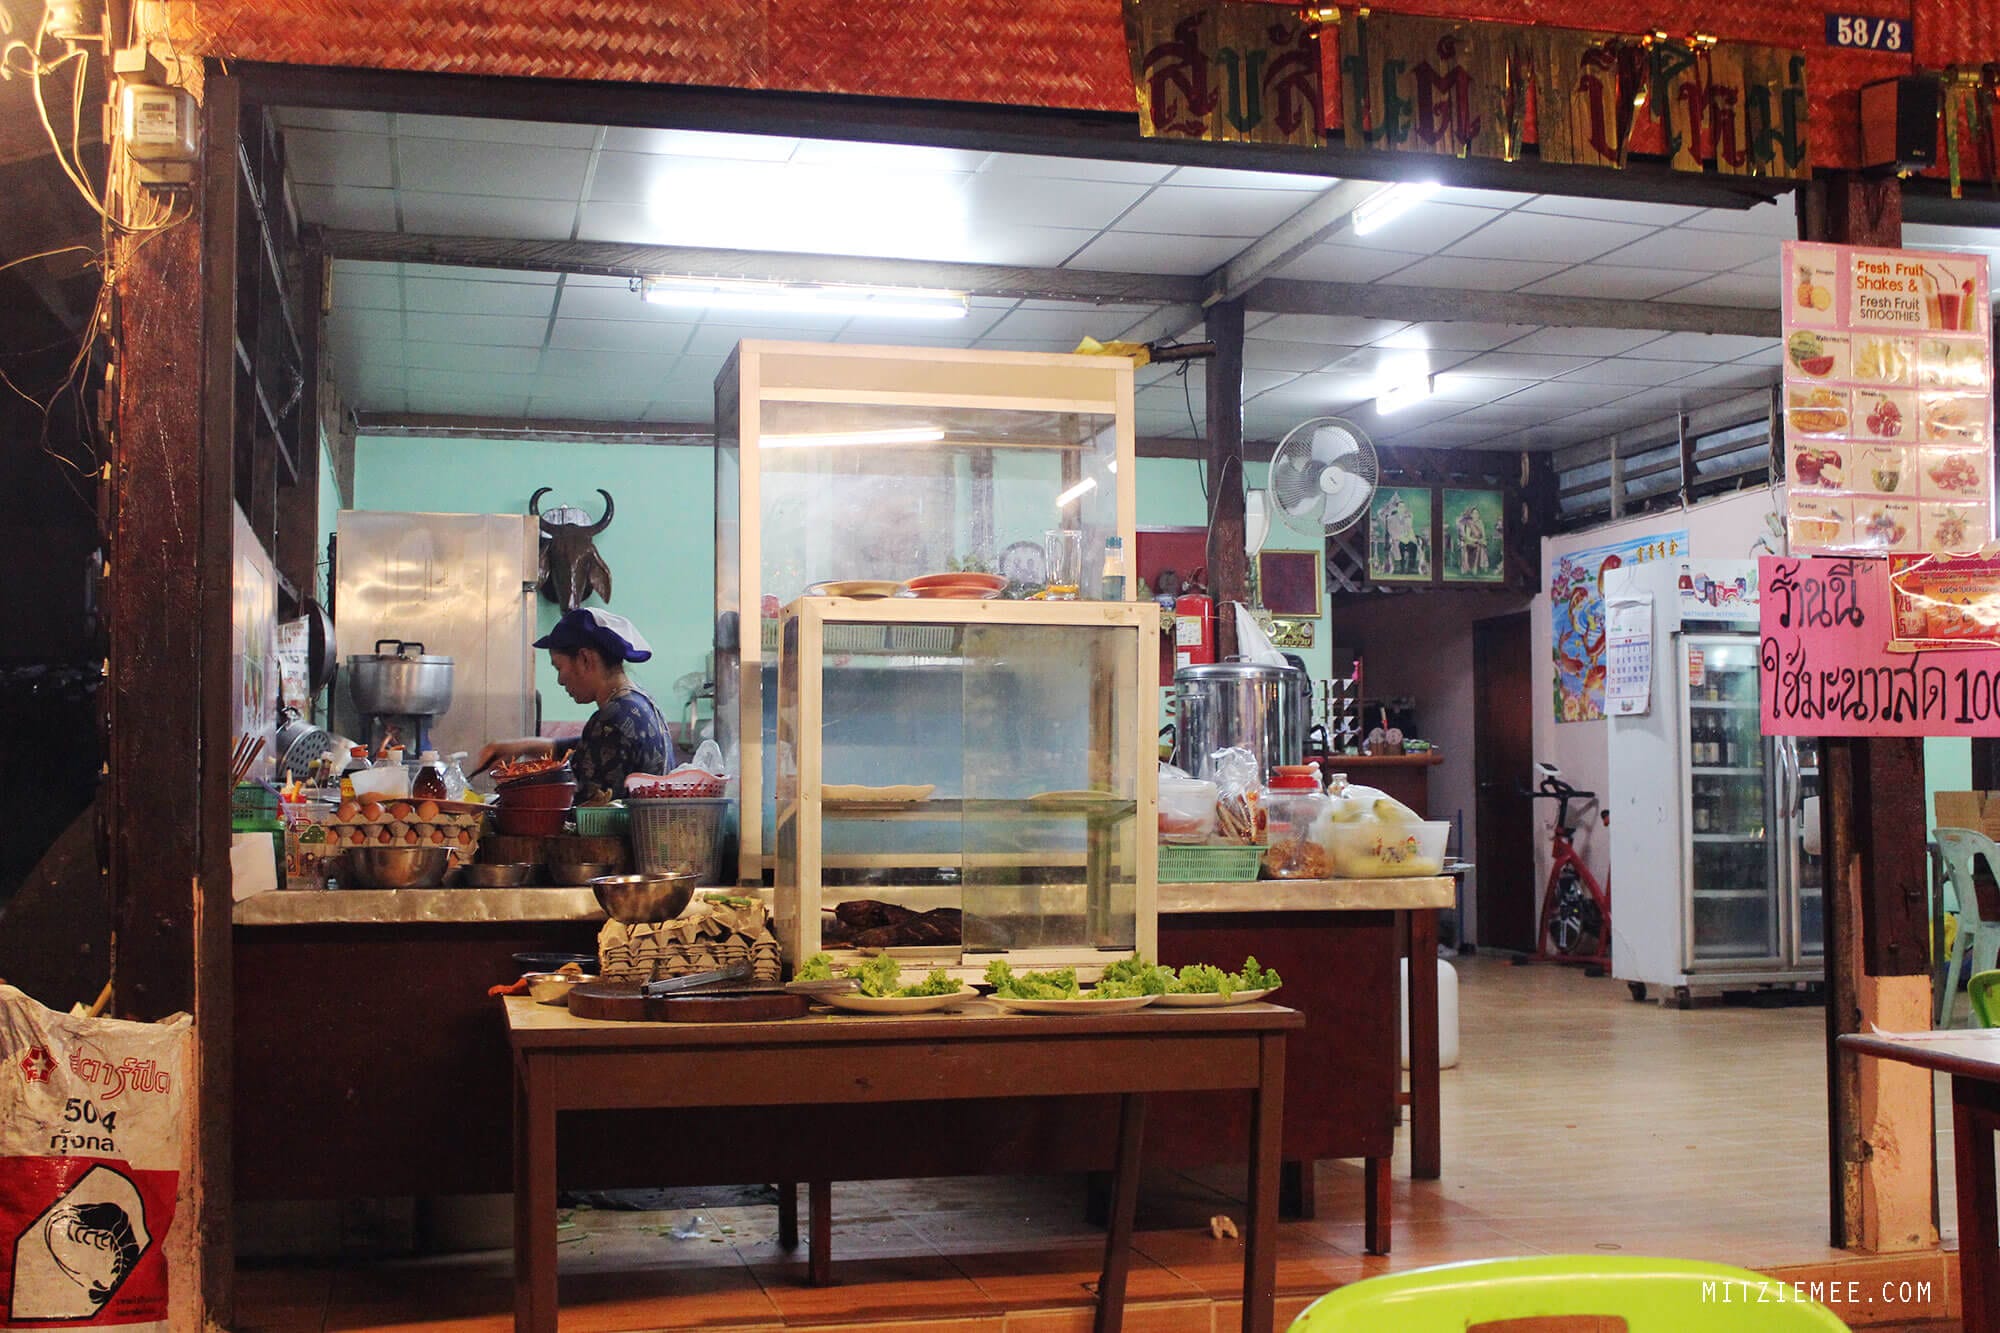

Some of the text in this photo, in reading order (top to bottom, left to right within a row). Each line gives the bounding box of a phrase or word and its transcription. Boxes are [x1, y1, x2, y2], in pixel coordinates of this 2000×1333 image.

[1837, 16, 1902, 50] 58/3
[1857, 260, 1924, 277] Fresh Fruit
[1856, 275, 1919, 293] Shakes &
[1860, 295, 1920, 310] Fresh Fruit
[1859, 308, 1921, 322] SMOOTHIES
[64, 1098, 117, 1134] 504
